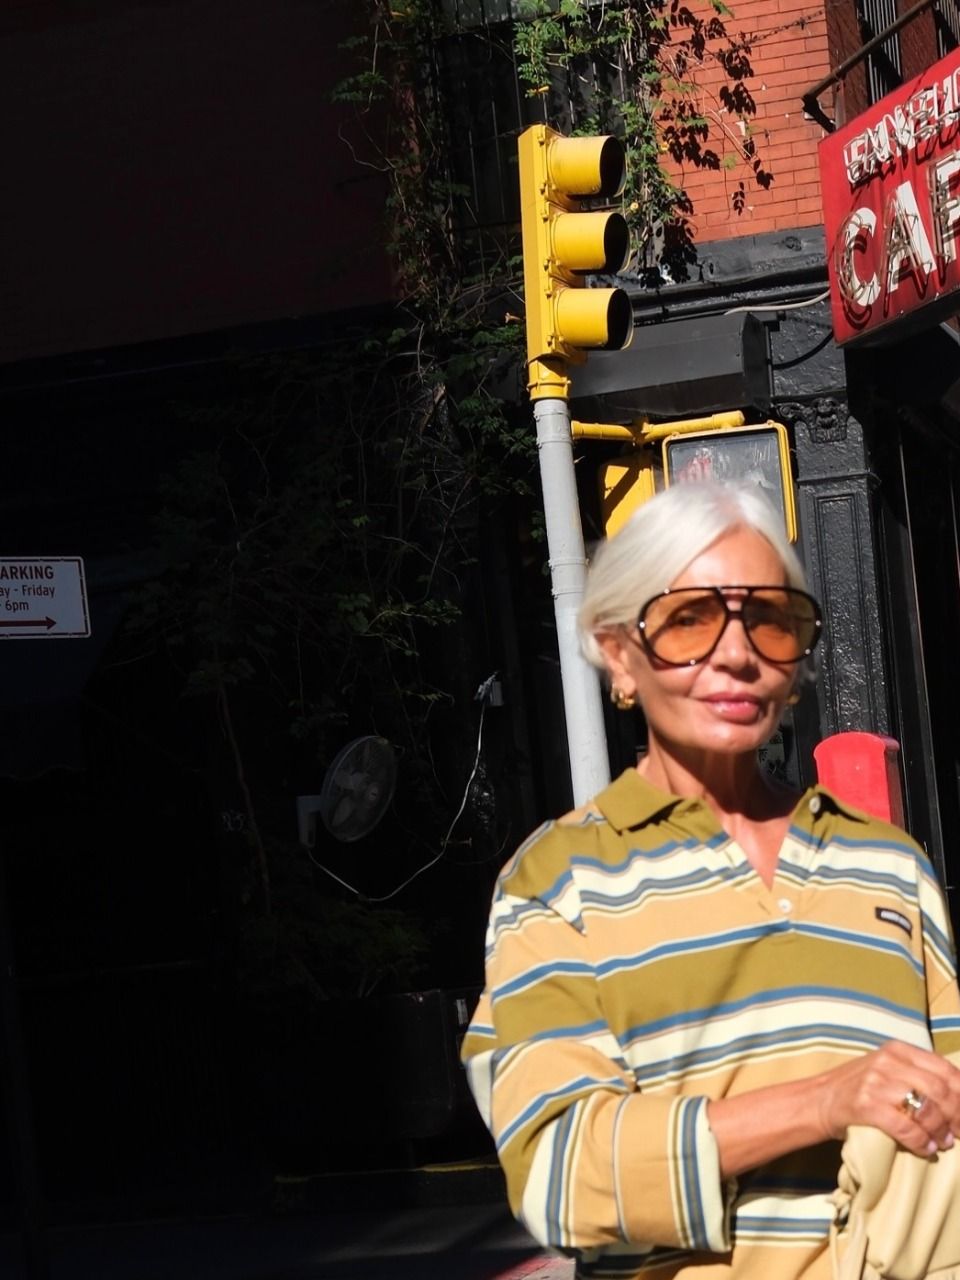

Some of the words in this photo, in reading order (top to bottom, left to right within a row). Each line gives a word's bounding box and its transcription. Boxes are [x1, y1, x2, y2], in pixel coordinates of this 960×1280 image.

[0, 566, 54, 580] ARKING
[22, 585, 55, 598] Friday
[5, 601, 29, 613] 6pm
